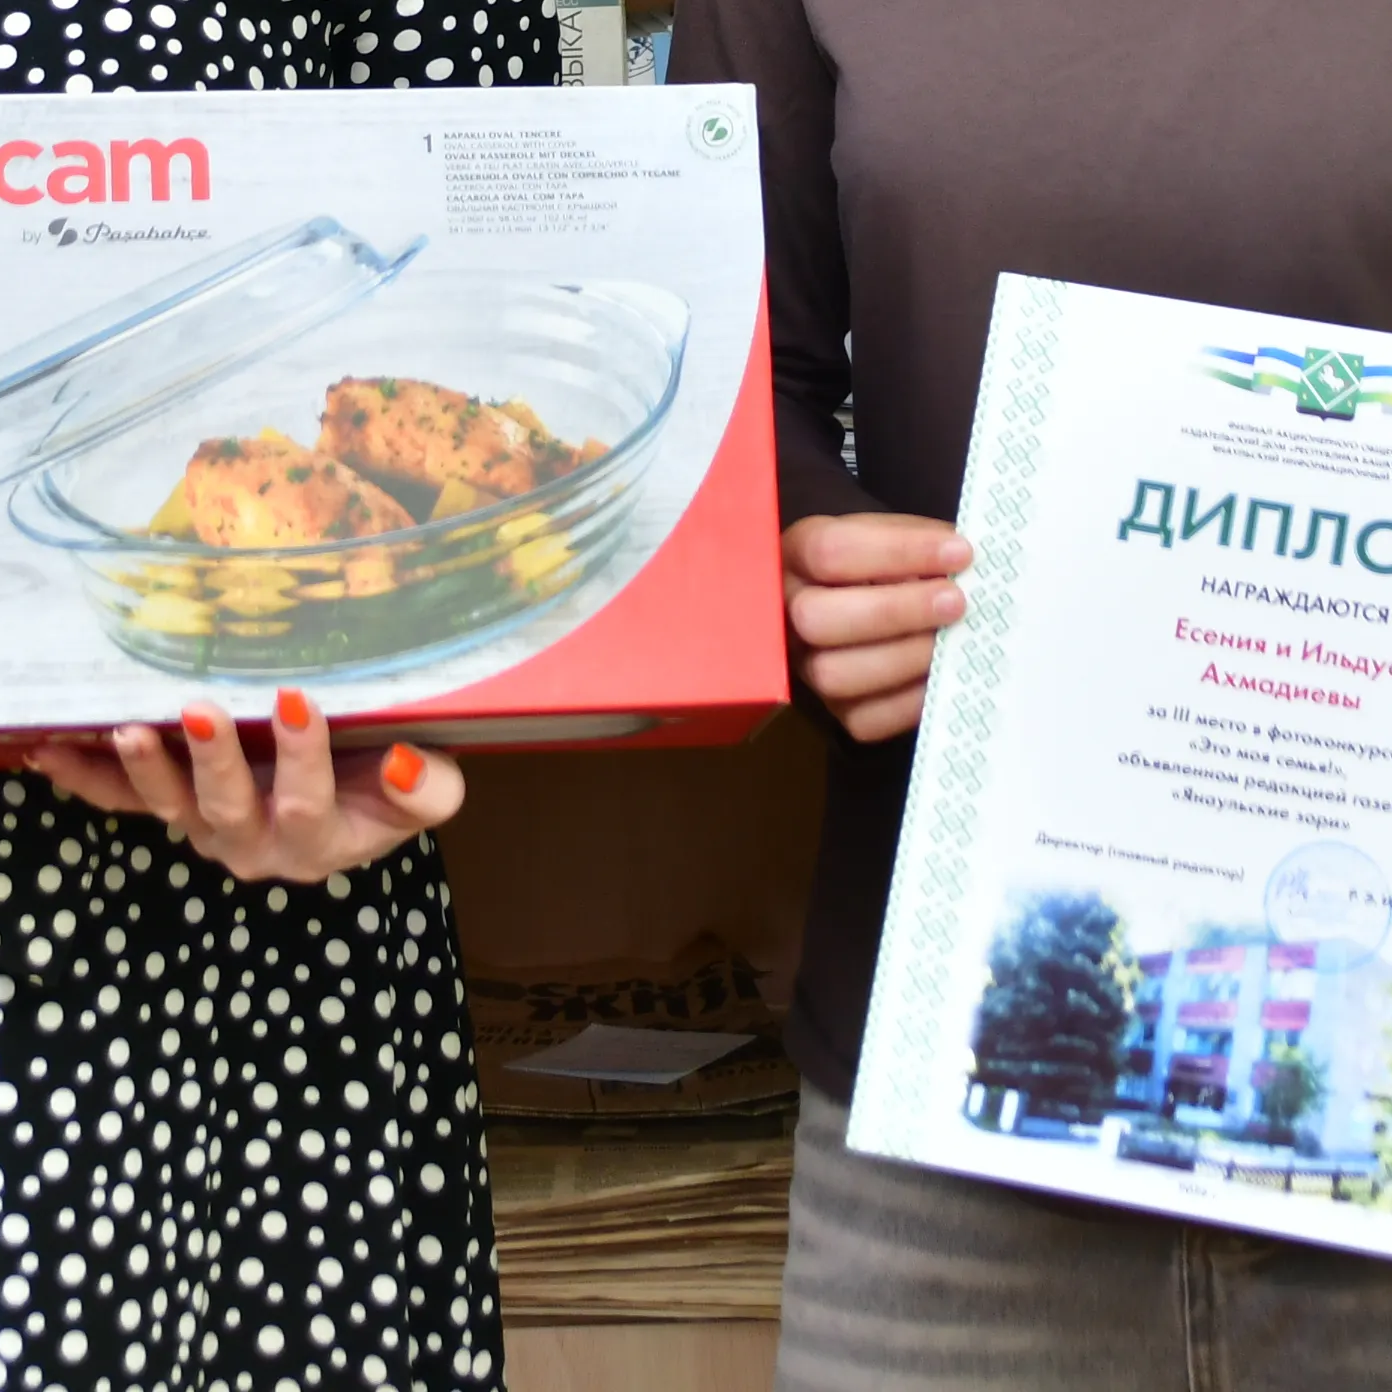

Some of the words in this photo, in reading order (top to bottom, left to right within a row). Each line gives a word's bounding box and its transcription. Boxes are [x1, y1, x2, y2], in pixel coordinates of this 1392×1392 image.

[422, 133, 433, 154] 1
[539, 151, 557, 160] MIT
[512, 172, 545, 181] OVALE
[547, 171, 569, 181] CON
[503, 193, 530, 202] OVAL
[22, 225, 42, 246] by
[1200, 575, 1391, 625] НАГРАЖДАЮТСЯ
[1174, 616, 1268, 655] Есения
[1275, 642, 1292, 659] и
[1200, 661, 1363, 711] Ахмадиевы
[1145, 705, 1168, 720] за
[1195, 715, 1248, 735] место
[1252, 724, 1262, 736] в
[1237, 748, 1270, 764] моя
[1244, 775, 1348, 809] редакцией
